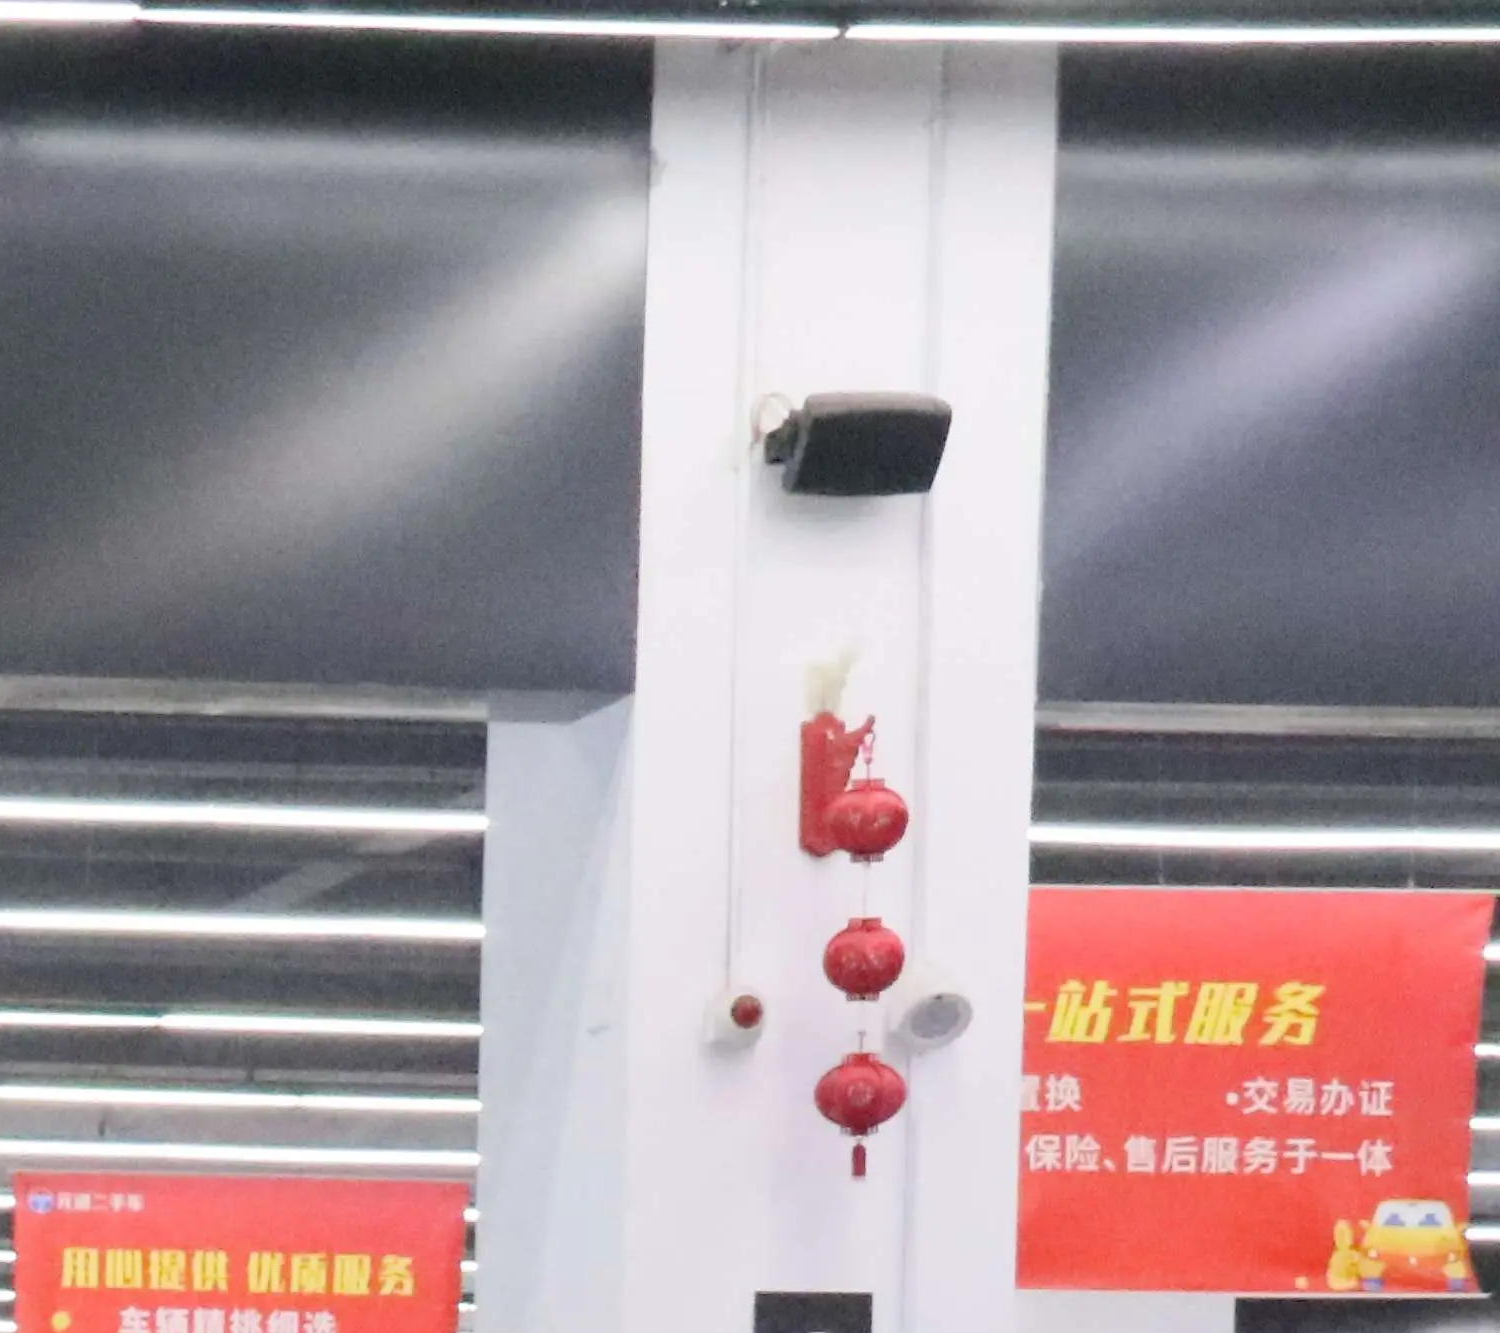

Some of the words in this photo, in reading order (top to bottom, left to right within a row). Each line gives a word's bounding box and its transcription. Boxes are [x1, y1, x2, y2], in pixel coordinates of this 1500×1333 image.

[1242, 1076, 1394, 1117] 交易办证
[1024, 1134, 1395, 1177] 保险、售后服务于一体
[60, 1247, 229, 1292] 用心提供
[247, 1251, 415, 1296] 优质服务
